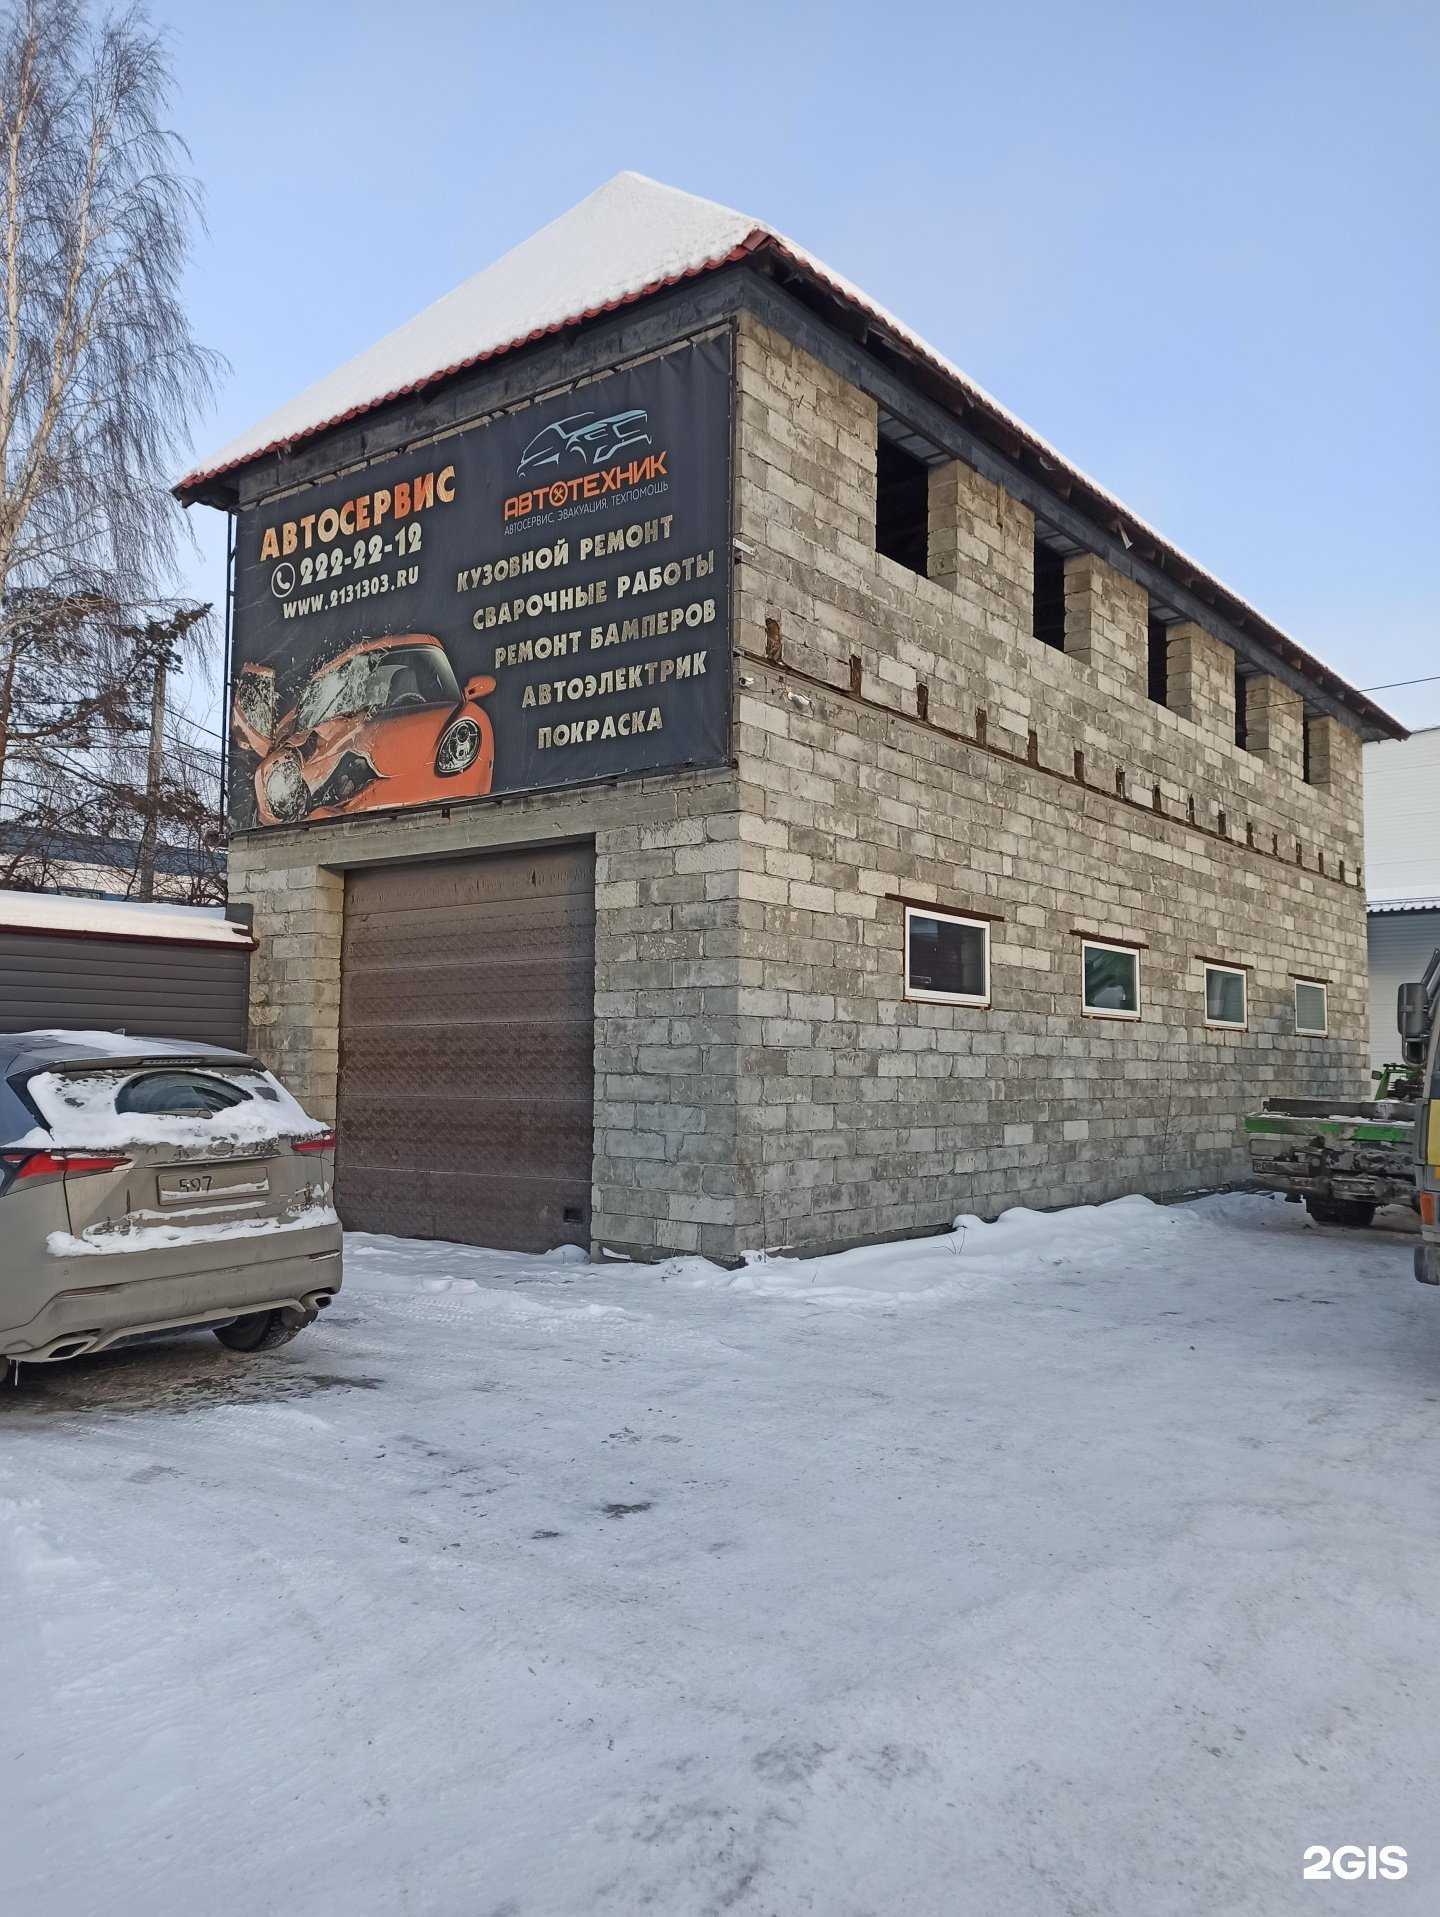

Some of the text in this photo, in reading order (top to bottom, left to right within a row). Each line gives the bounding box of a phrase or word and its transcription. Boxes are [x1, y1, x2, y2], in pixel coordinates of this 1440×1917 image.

[260, 465, 456, 561] АВТОСЕРВИС
[504, 451, 669, 520] АВТОТЕХНИК
[611, 482, 669, 506] ТЕХПОМОЩЬ
[300, 522, 422, 586] 222-22-12
[456, 515, 673, 593] КУЗОВНОЙ РЕМОНТ
[282, 566, 419, 619] WWW.2131303.RU
[472, 550, 714, 630] СВАРОЧНЫЕ РАБОТЫ
[495, 599, 716, 669] РЕМОНТ БАМПЕРОВ
[521, 651, 708, 708] АВТОЭЛЕКТРИК
[537, 707, 663, 749] ПОКРАСКА
